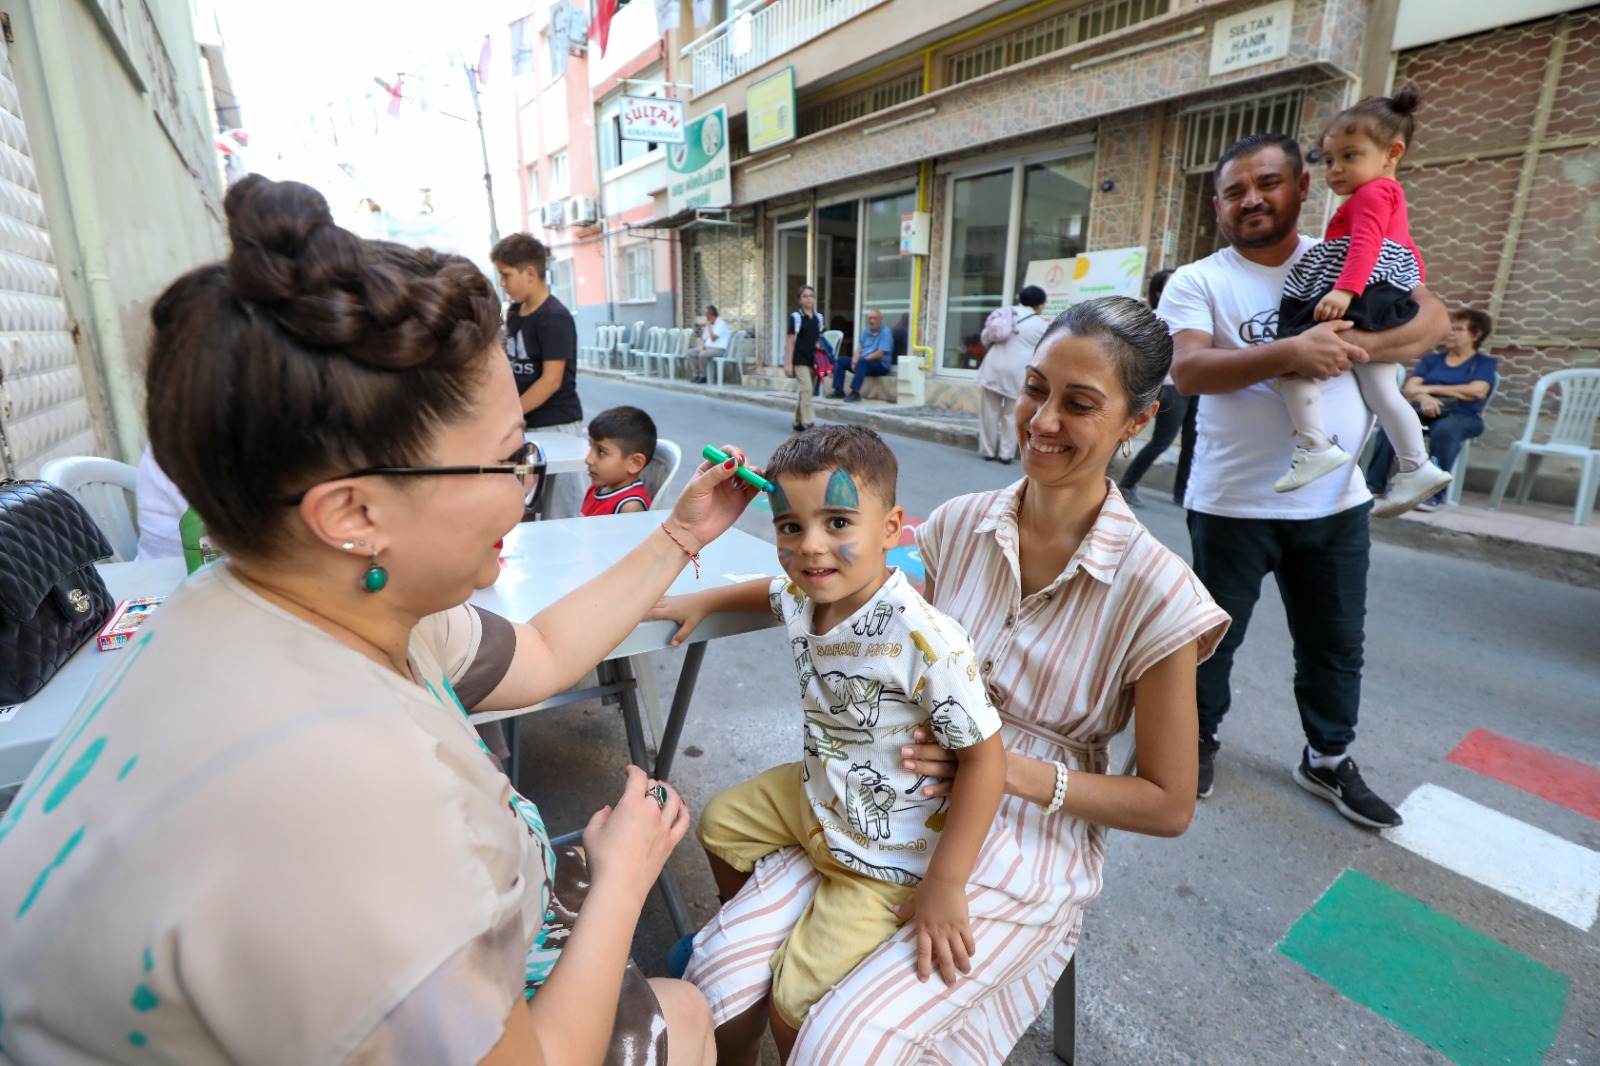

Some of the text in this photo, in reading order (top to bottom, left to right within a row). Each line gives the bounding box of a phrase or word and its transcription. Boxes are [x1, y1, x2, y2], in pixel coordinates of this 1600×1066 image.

[1229, 14, 1274, 38] SULTAN
[1231, 32, 1267, 52] HANIM
[625, 105, 680, 128] SULTAN
[816, 642, 862, 657] SAFARI
[817, 817, 870, 850] SAFARI
